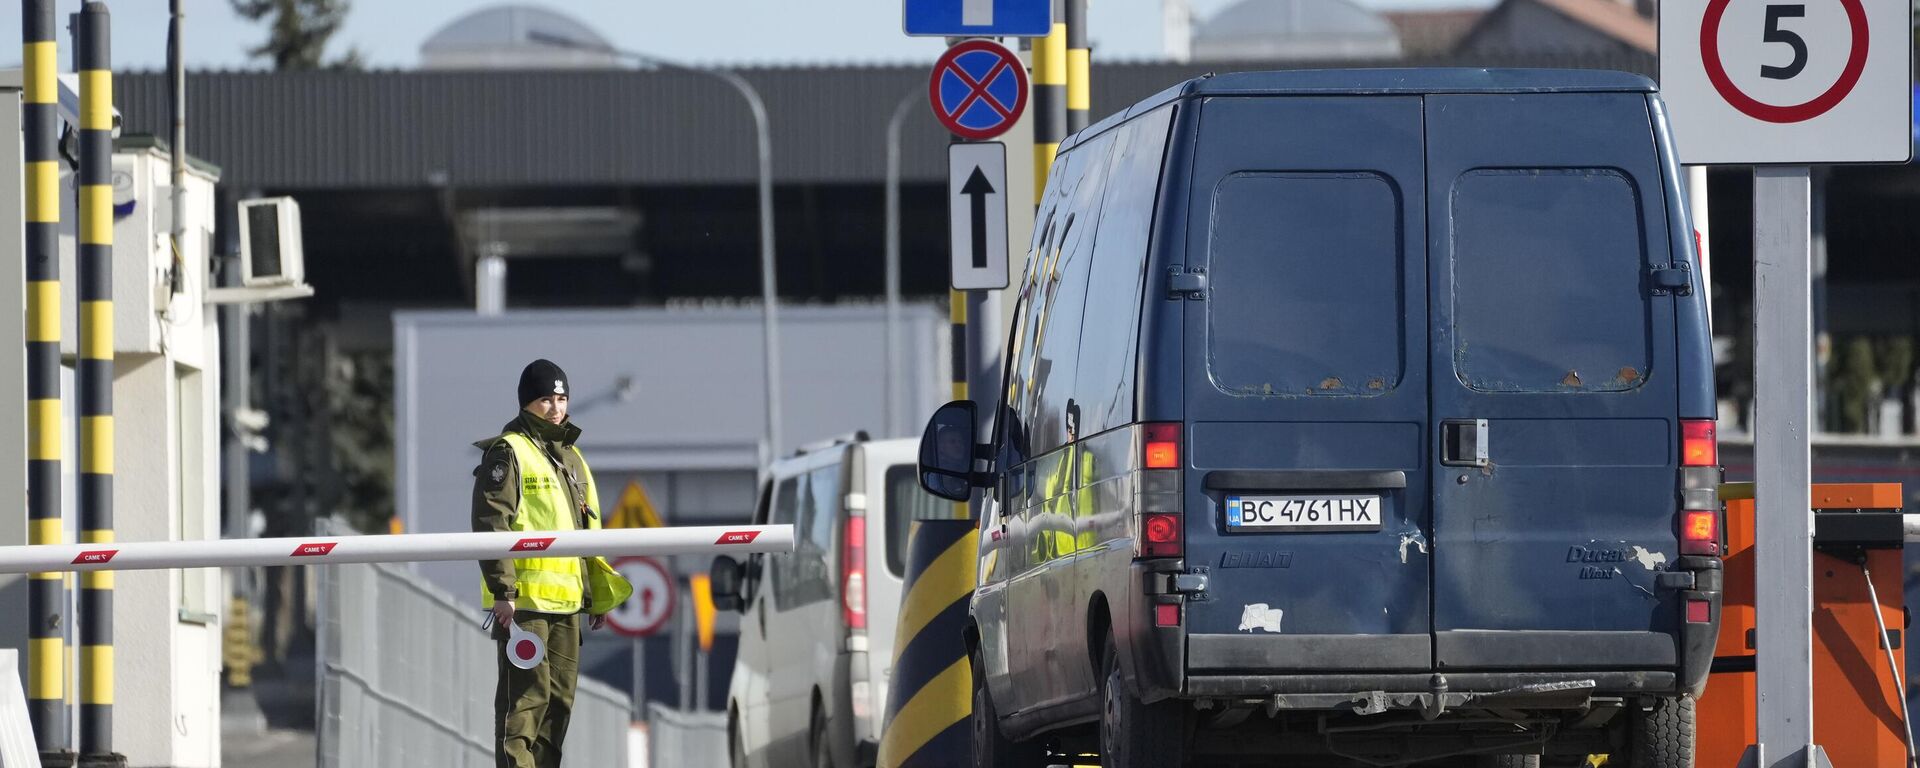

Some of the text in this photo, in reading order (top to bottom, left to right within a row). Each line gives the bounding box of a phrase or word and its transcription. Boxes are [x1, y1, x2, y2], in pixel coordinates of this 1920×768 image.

[1760, 4, 1808, 80] 5
[1241, 499, 1372, 523] BC 4761 HX
[1222, 552, 1292, 568] FIAT
